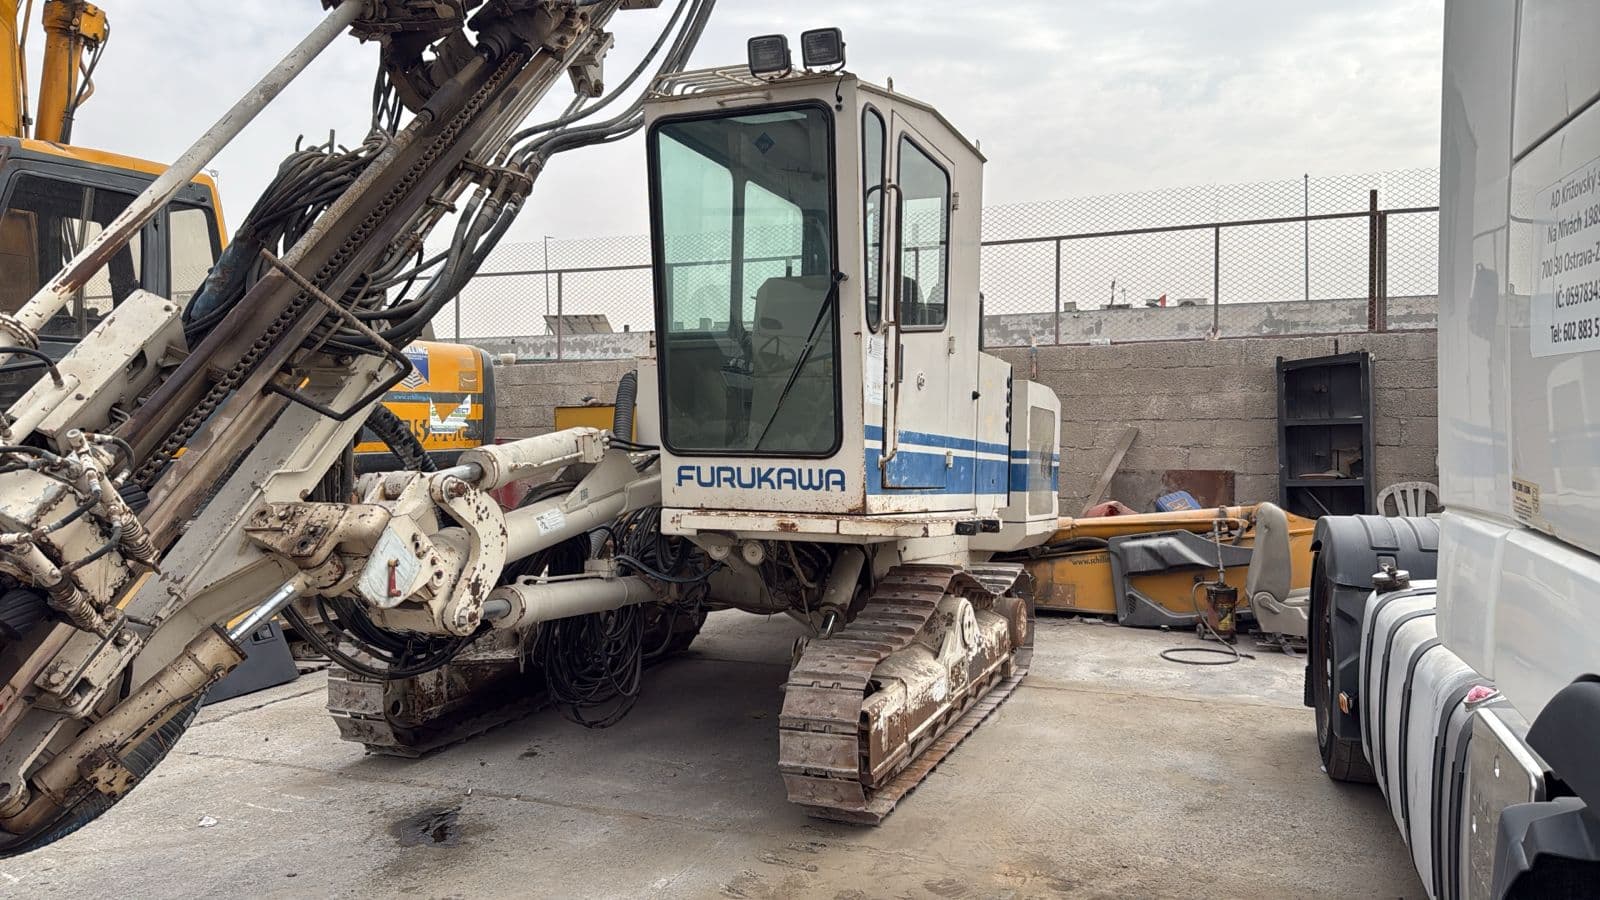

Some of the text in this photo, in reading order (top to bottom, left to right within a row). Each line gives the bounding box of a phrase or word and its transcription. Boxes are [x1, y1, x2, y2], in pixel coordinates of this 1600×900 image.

[1551, 189, 1560, 210] AD
[1562, 168, 1596, 204] Křižovský
[1547, 202, 1600, 244] Na Nivách 198
[1541, 258, 1553, 280] 700
[1554, 255, 1562, 276] 30
[1556, 283, 1564, 309] IČ:
[1550, 317, 1599, 343] Tel: 602 883 5
[677, 465, 846, 491] FURUKAWA
